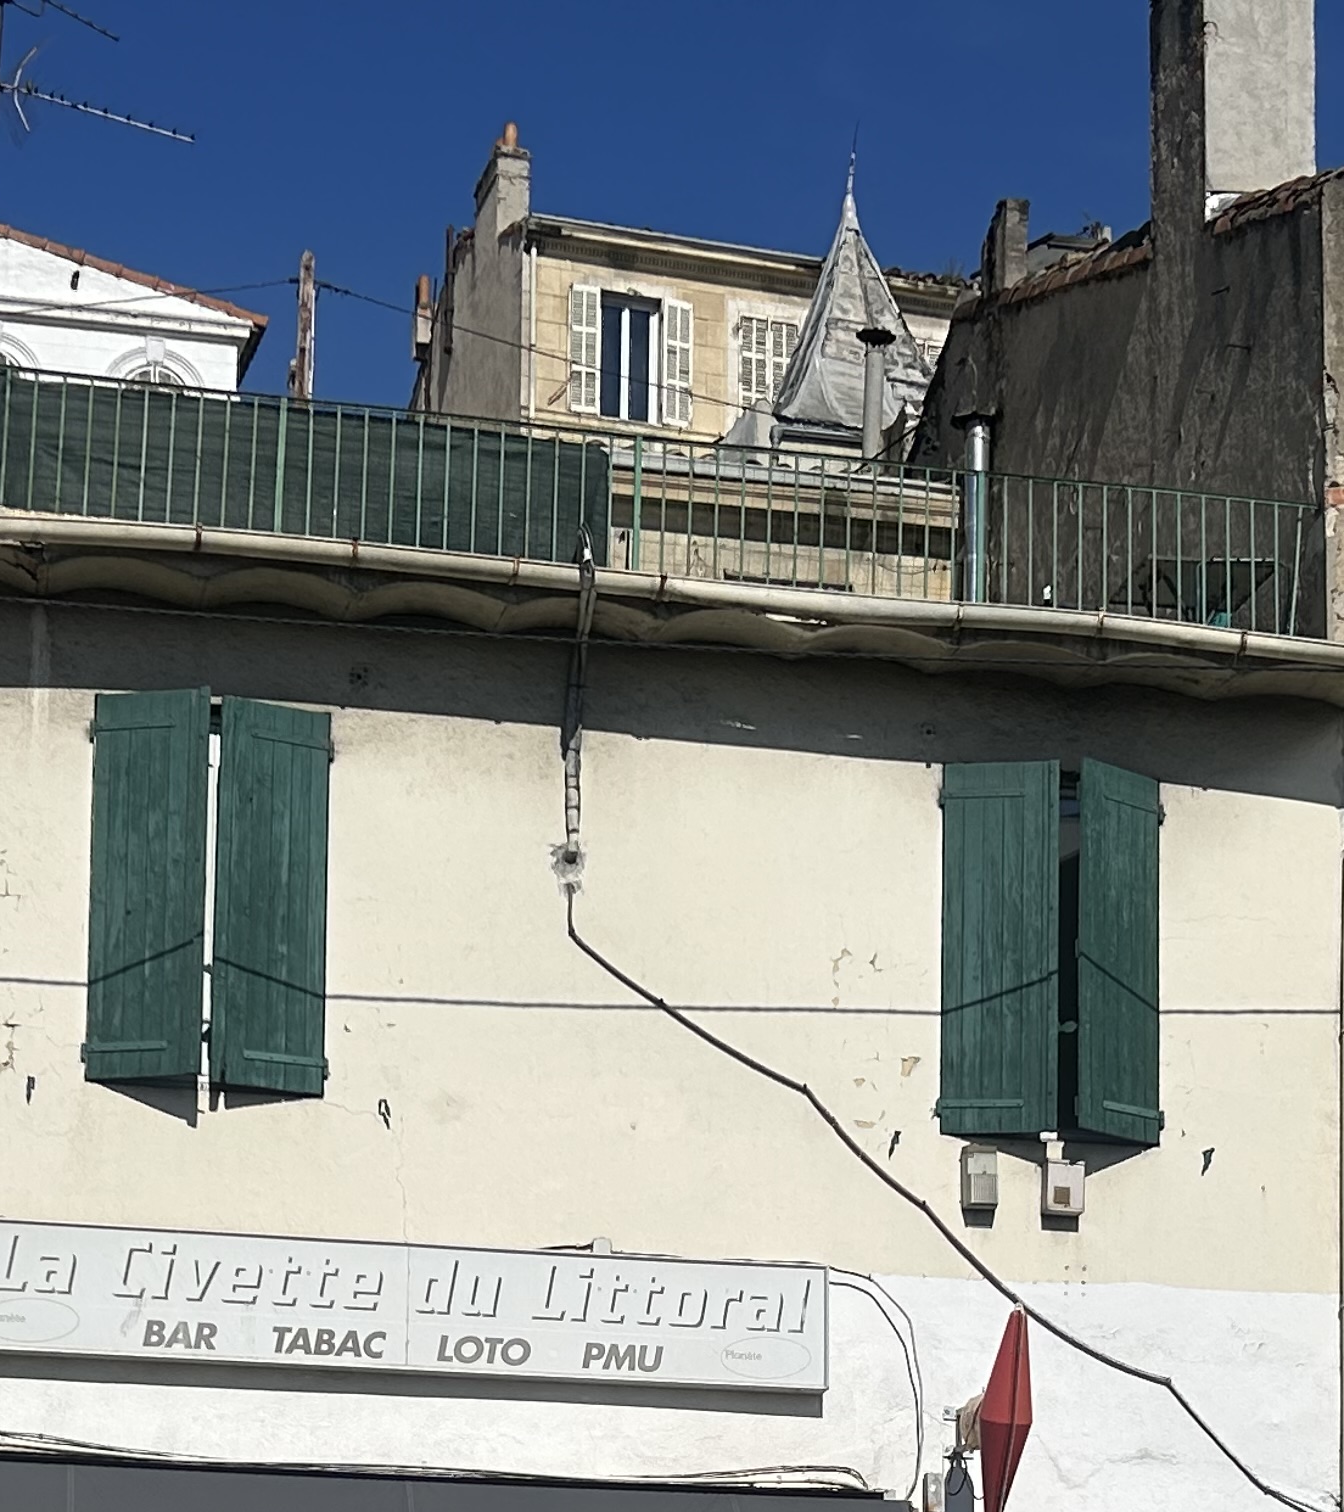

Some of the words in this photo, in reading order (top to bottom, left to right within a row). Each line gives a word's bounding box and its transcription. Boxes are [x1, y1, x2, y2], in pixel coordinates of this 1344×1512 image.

[112, 1242, 384, 1311] Civette
[415, 1260, 503, 1318] du
[531, 1266, 812, 1333] Littoral
[142, 1319, 218, 1350] BAR
[272, 1325, 387, 1359] TABAC
[436, 1334, 532, 1367] LOTO
[582, 1341, 664, 1372] PMU
